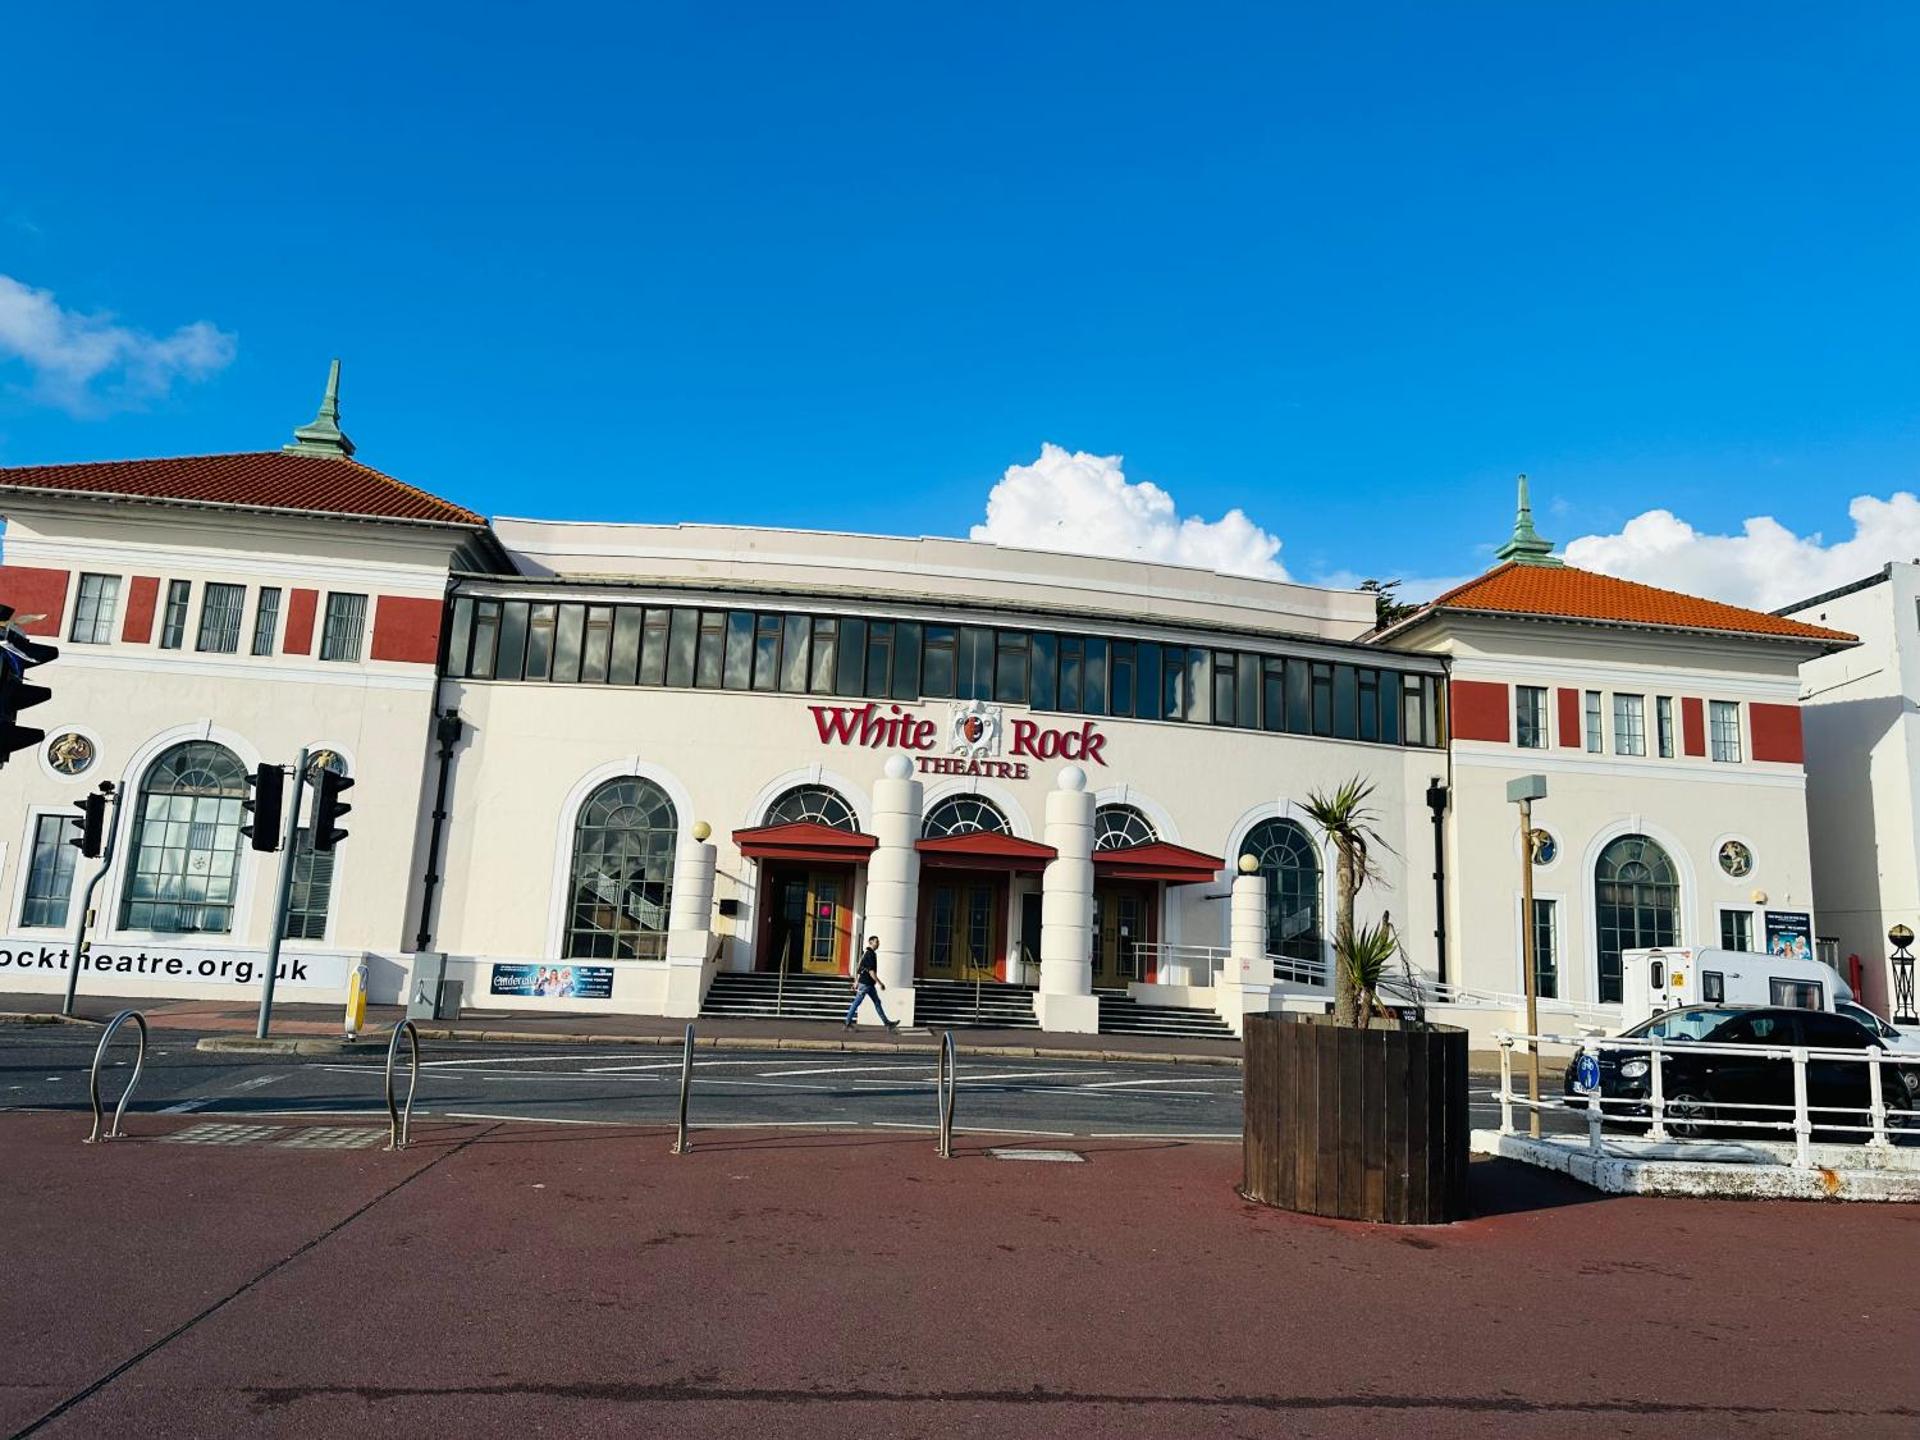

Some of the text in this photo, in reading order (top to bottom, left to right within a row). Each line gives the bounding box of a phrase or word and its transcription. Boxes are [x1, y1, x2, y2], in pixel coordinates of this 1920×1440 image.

[807, 703, 1108, 767] White Rock
[915, 756, 1029, 780] THEATRE
